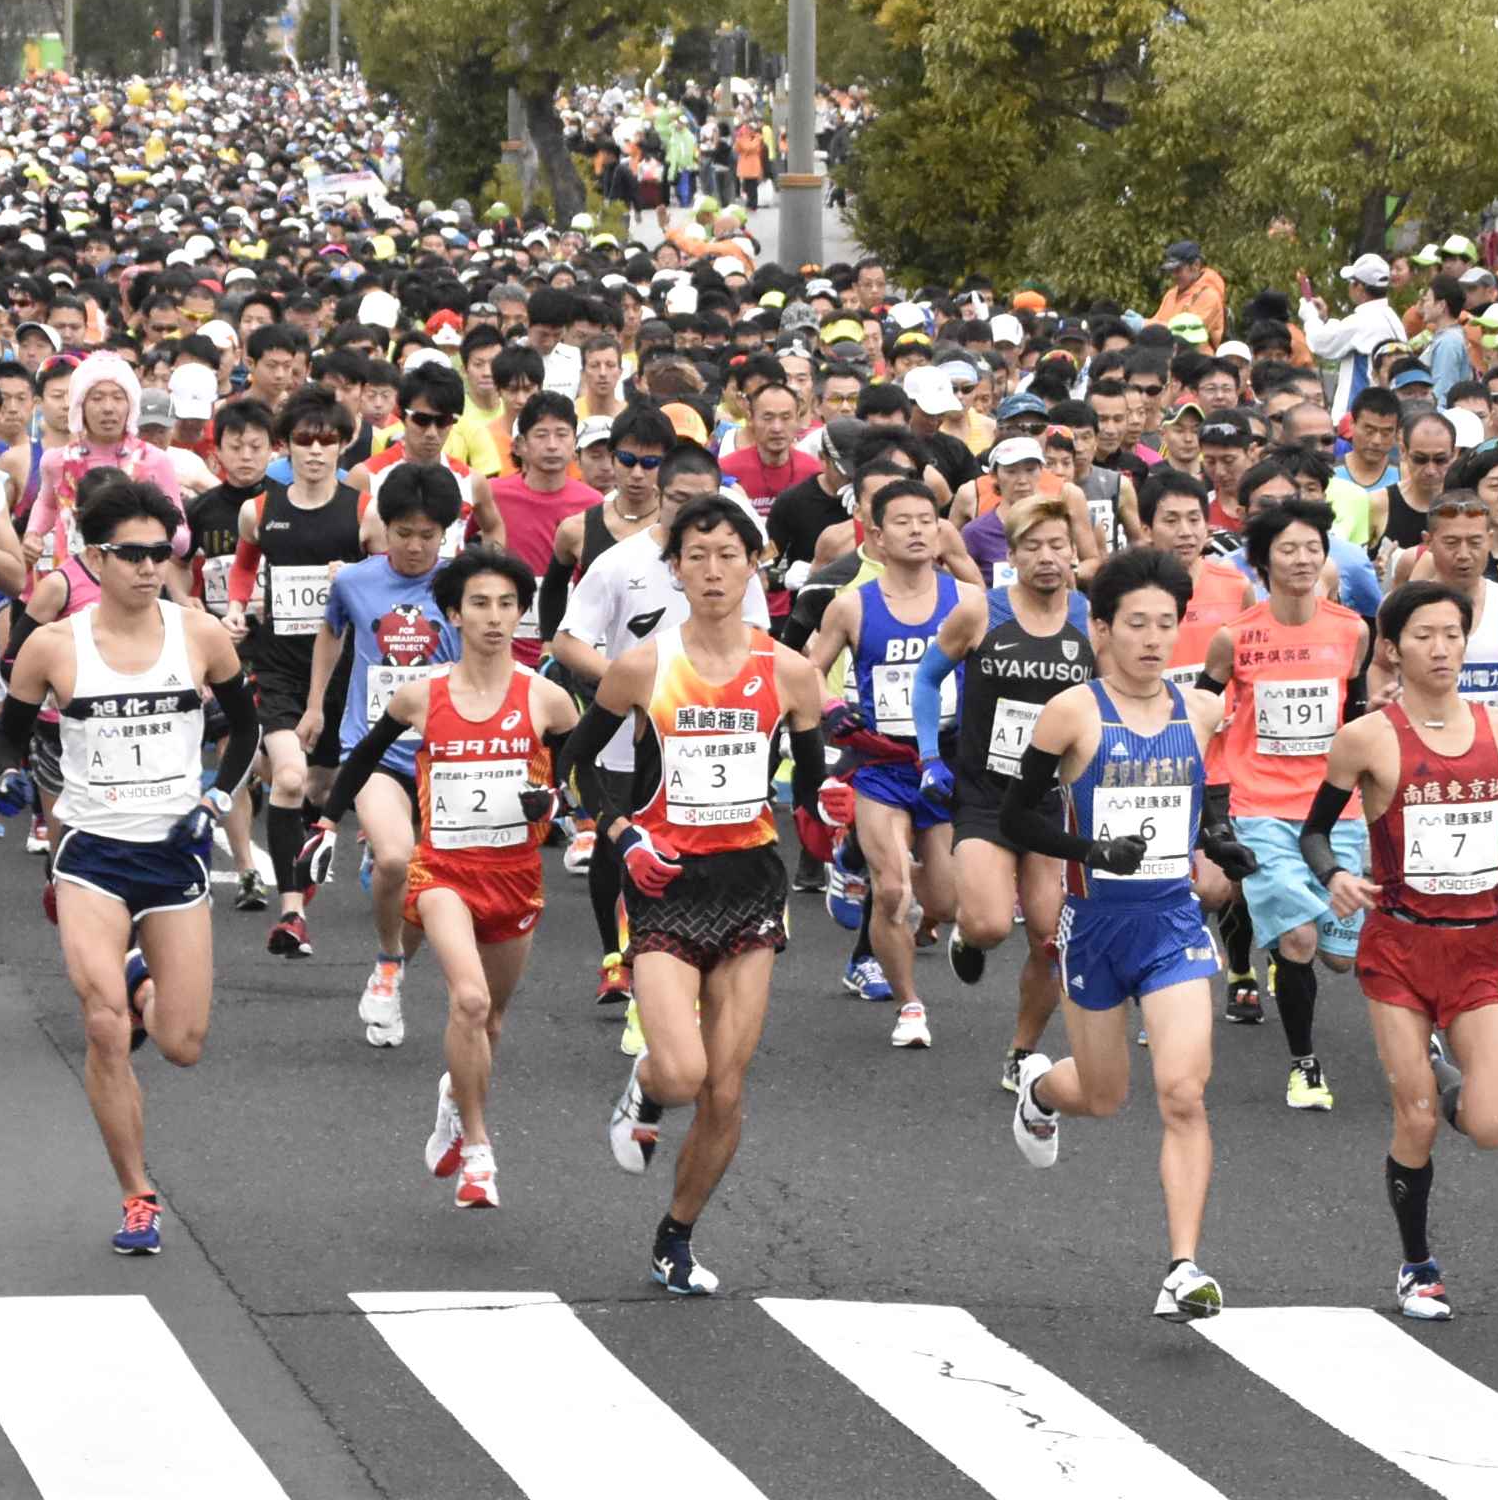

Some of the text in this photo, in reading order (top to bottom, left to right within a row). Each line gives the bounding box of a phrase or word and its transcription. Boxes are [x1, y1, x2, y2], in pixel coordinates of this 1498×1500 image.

[274, 586, 328, 607] A 106
[384, 635, 430, 643] KUMAMOTO
[400, 627, 416, 635] FOR
[390, 644, 425, 652] PROJECT
[981, 659, 1092, 682] GYAKUSOU
[878, 693, 888, 707] A
[1285, 687, 1329, 699] 健康家族
[91, 696, 180, 717] 旭化成
[371, 696, 381, 709] A
[677, 708, 757, 732] 黒崎播磨
[1259, 703, 1324, 724] A 191
[122, 721, 172, 738] 健康家族
[996, 727, 1006, 742] A
[429, 738, 530, 756] トヨタ九州
[705, 741, 757, 757] 健康家族
[91, 744, 142, 768] A 1
[670, 764, 727, 788] A 3
[435, 789, 488, 813] A 2
[1135, 795, 1182, 809] 健康家族
[697, 807, 751, 821] KYOCERA
[1444, 811, 1493, 826] 健康家族
[1098, 816, 1156, 842] A 6
[1410, 833, 1466, 858] A 7
